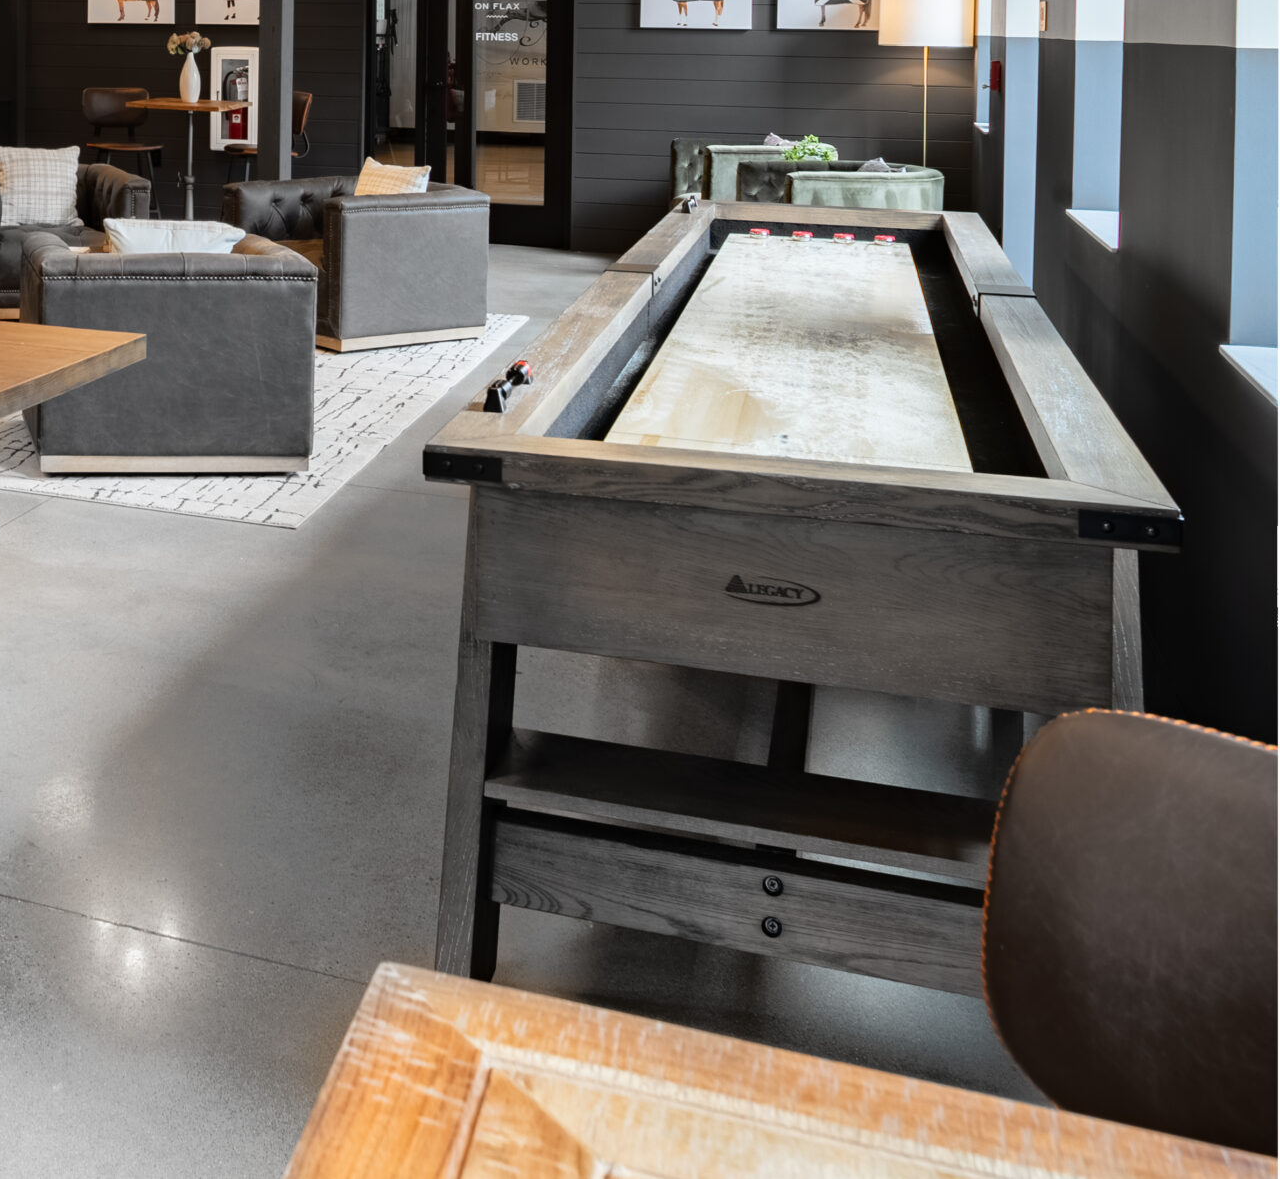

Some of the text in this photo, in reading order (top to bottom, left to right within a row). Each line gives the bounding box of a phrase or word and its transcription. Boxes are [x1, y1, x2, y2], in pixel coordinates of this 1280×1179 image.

[474, 2, 520, 10] ON FLAX
[475, 32, 519, 42] FITNESS
[747, 583, 805, 600] LEGACY
